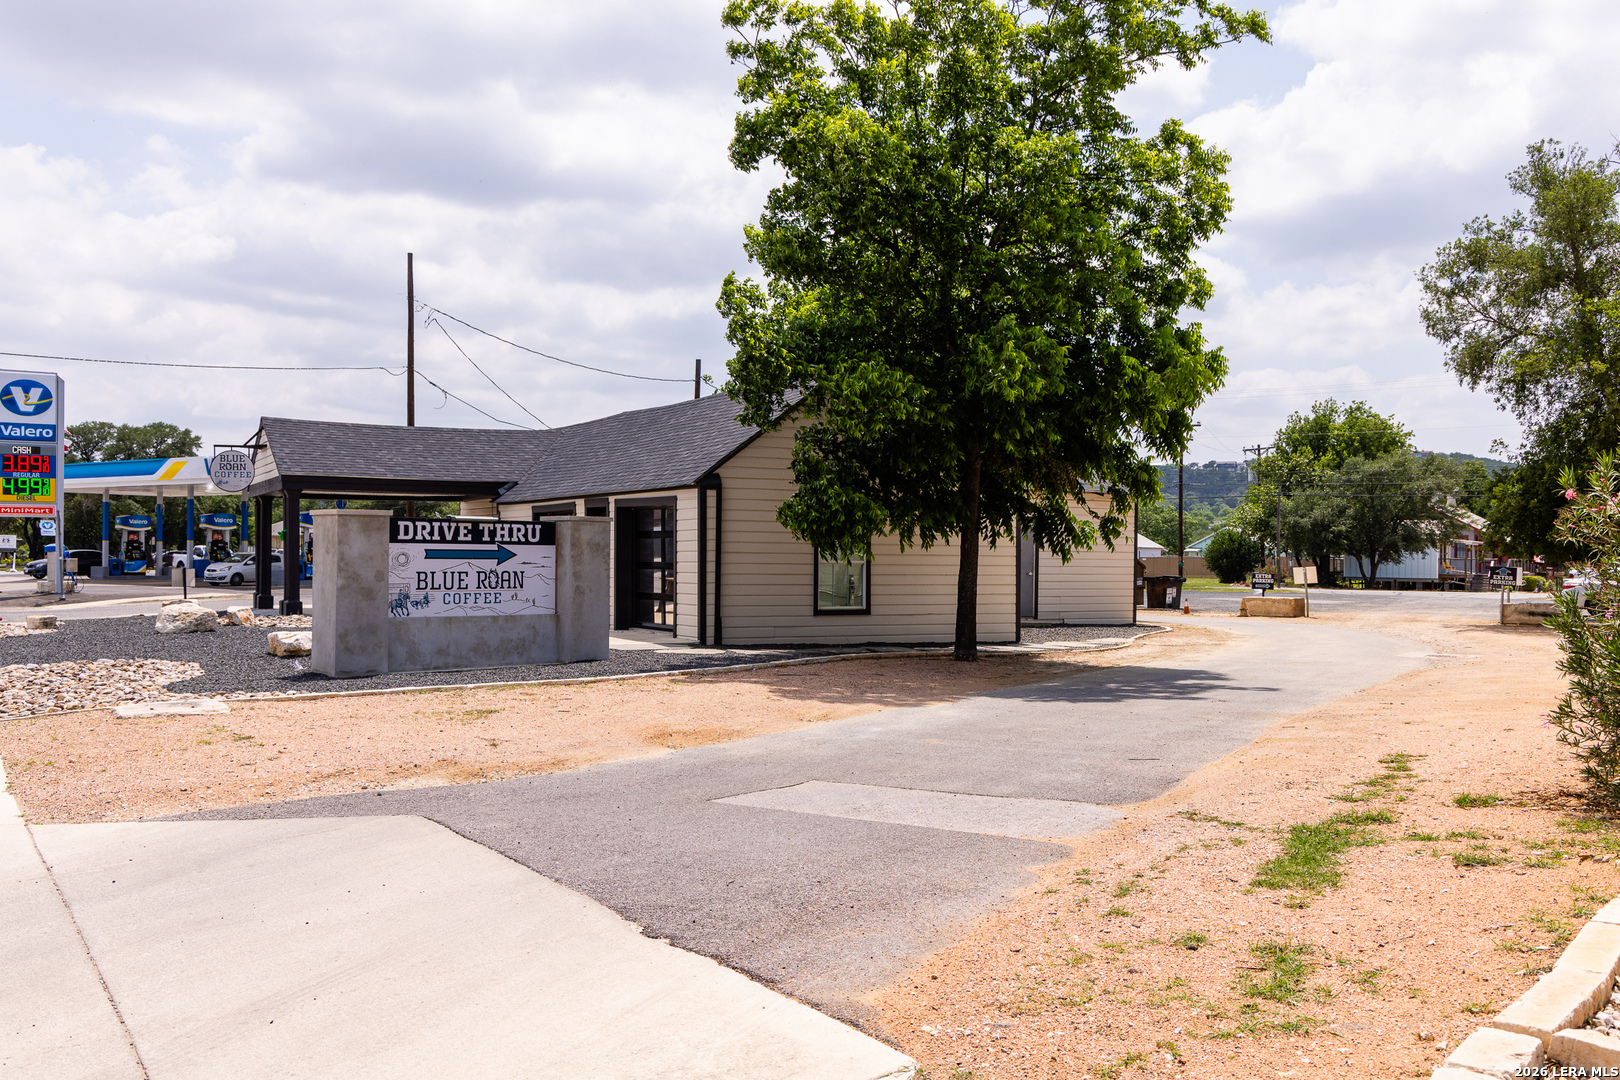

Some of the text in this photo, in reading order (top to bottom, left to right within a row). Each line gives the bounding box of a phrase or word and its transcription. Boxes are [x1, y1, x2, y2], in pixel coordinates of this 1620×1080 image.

[0, 424, 53, 438] Valero
[12, 446, 32, 454] CASH
[219, 462, 246, 470] ROAN
[397, 520, 542, 543] DRIVE THRU
[416, 569, 525, 591] BLUE ROAN
[443, 592, 502, 605] COFFEE
